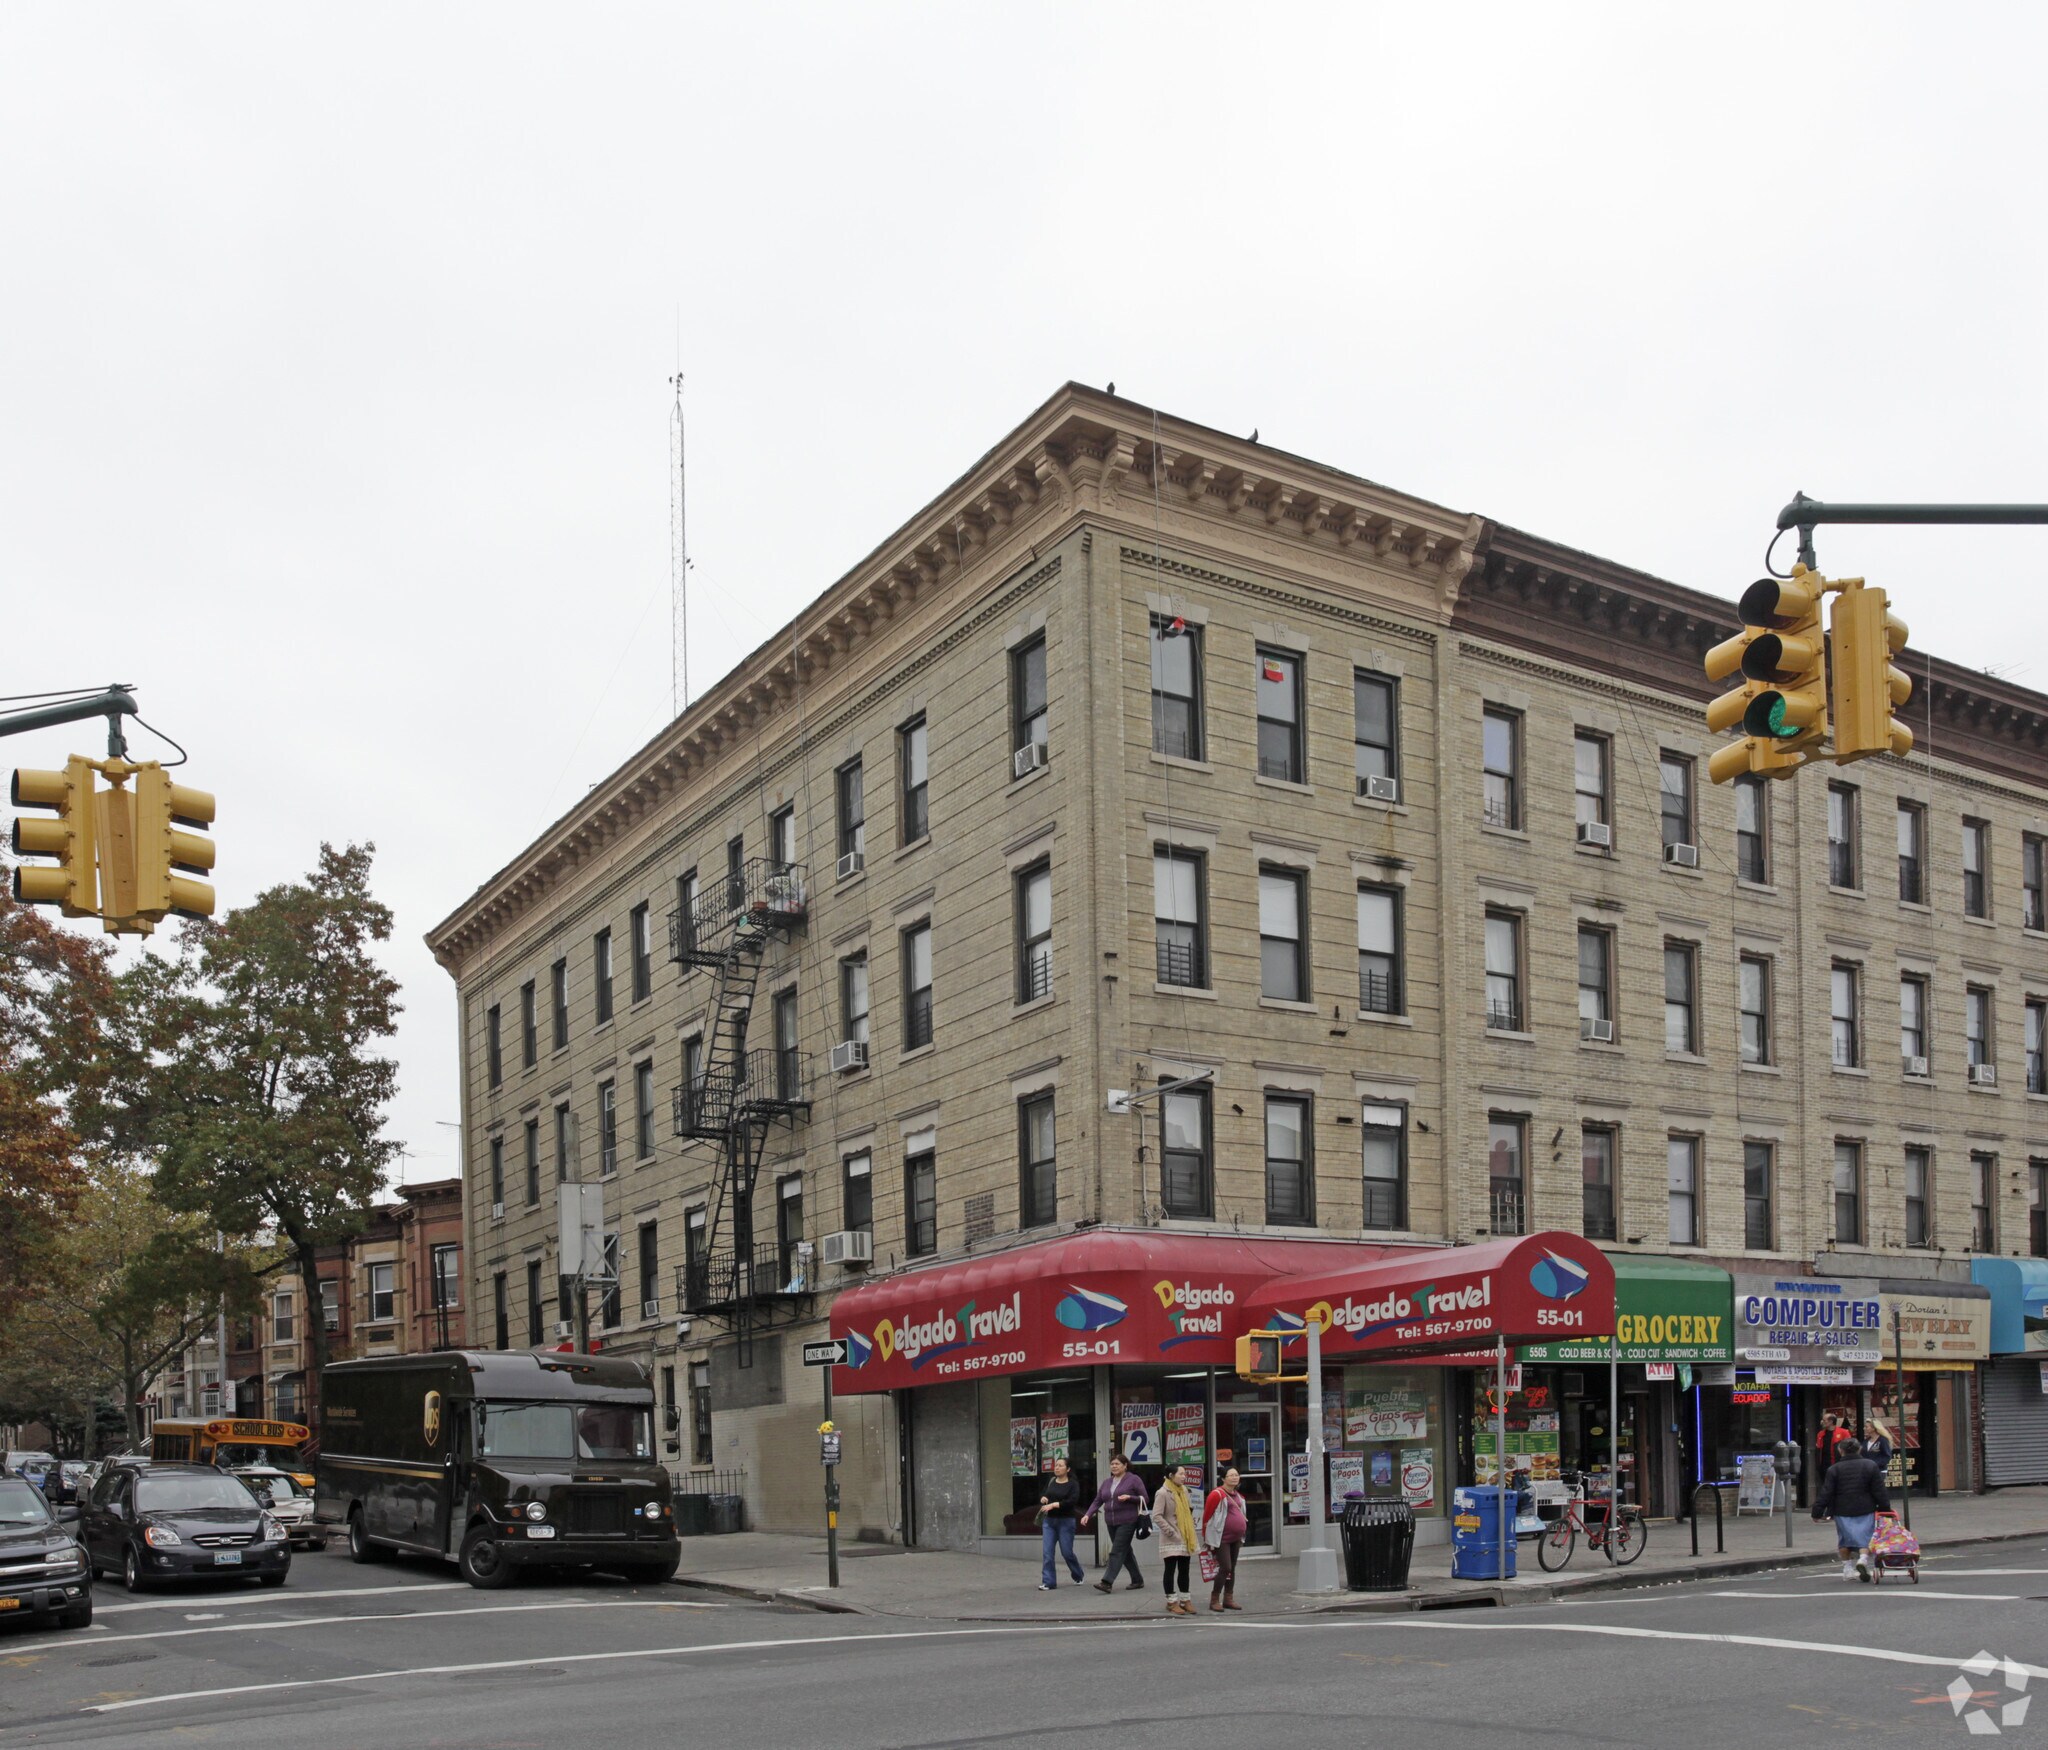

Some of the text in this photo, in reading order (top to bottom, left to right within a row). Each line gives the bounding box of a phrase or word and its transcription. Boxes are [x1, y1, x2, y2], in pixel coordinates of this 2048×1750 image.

[1153, 1280, 1234, 1310] Delgado
[1313, 1276, 1491, 1335] Delgado Travel
[1745, 1296, 1880, 1328] COMPUTER
[1906, 1302, 1947, 1314] Dorian's
[1168, 1309, 1222, 1334] Travel
[1537, 1309, 1583, 1326] 55-01
[873, 1291, 1021, 1362] Delgado Travel
[1396, 1317, 1492, 1340] Tel: 567-9700
[1617, 1314, 1721, 1344] GROCERY
[1769, 1330, 1859, 1346] REPAIR & SALES
[807, 1347, 834, 1360] ONE WAY
[1063, 1340, 1120, 1358] 55-01
[1529, 1347, 1547, 1357] 5505
[1559, 1347, 1579, 1358] COLD
[1580, 1348, 1596, 1358] BEER
[1597, 1348, 1602, 1358] &
[1627, 1348, 1646, 1358] COLD
[1647, 1348, 1660, 1358] CUT
[1665, 1349, 1698, 1358] SANDWICH
[1702, 1348, 1726, 1358] COFFEE
[1747, 1350, 1760, 1358] 5505
[1762, 1350, 1774, 1358] 5TH
[936, 1350, 1026, 1374] Tel: 567-9700
[1648, 1363, 1673, 1375] ATM
[1824, 1367, 1847, 1375] EXPRESS
[1490, 1370, 1518, 1387] AM
[1364, 1390, 1408, 1405] Puebla
[1733, 1393, 1770, 1403] ECUADOR
[1123, 1404, 1160, 1418] ECUADOR
[1166, 1405, 1202, 1421] GIROS
[1369, 1411, 1400, 1422] Giros
[426, 1408, 439, 1437] ups
[1042, 1419, 1067, 1430] PERU
[1123, 1418, 1159, 1431] Giros
[233, 1423, 284, 1437] SCHOOL BUS
[1047, 1429, 1067, 1440] Giros
[1131, 1430, 1147, 1461] 2
[1167, 1431, 1198, 1450] México
[1289, 1455, 1308, 1466] Reca
[1331, 1459, 1362, 1470] Guatemala
[1292, 1466, 1308, 1475] Grati
[1337, 1469, 1360, 1479] Pagos
